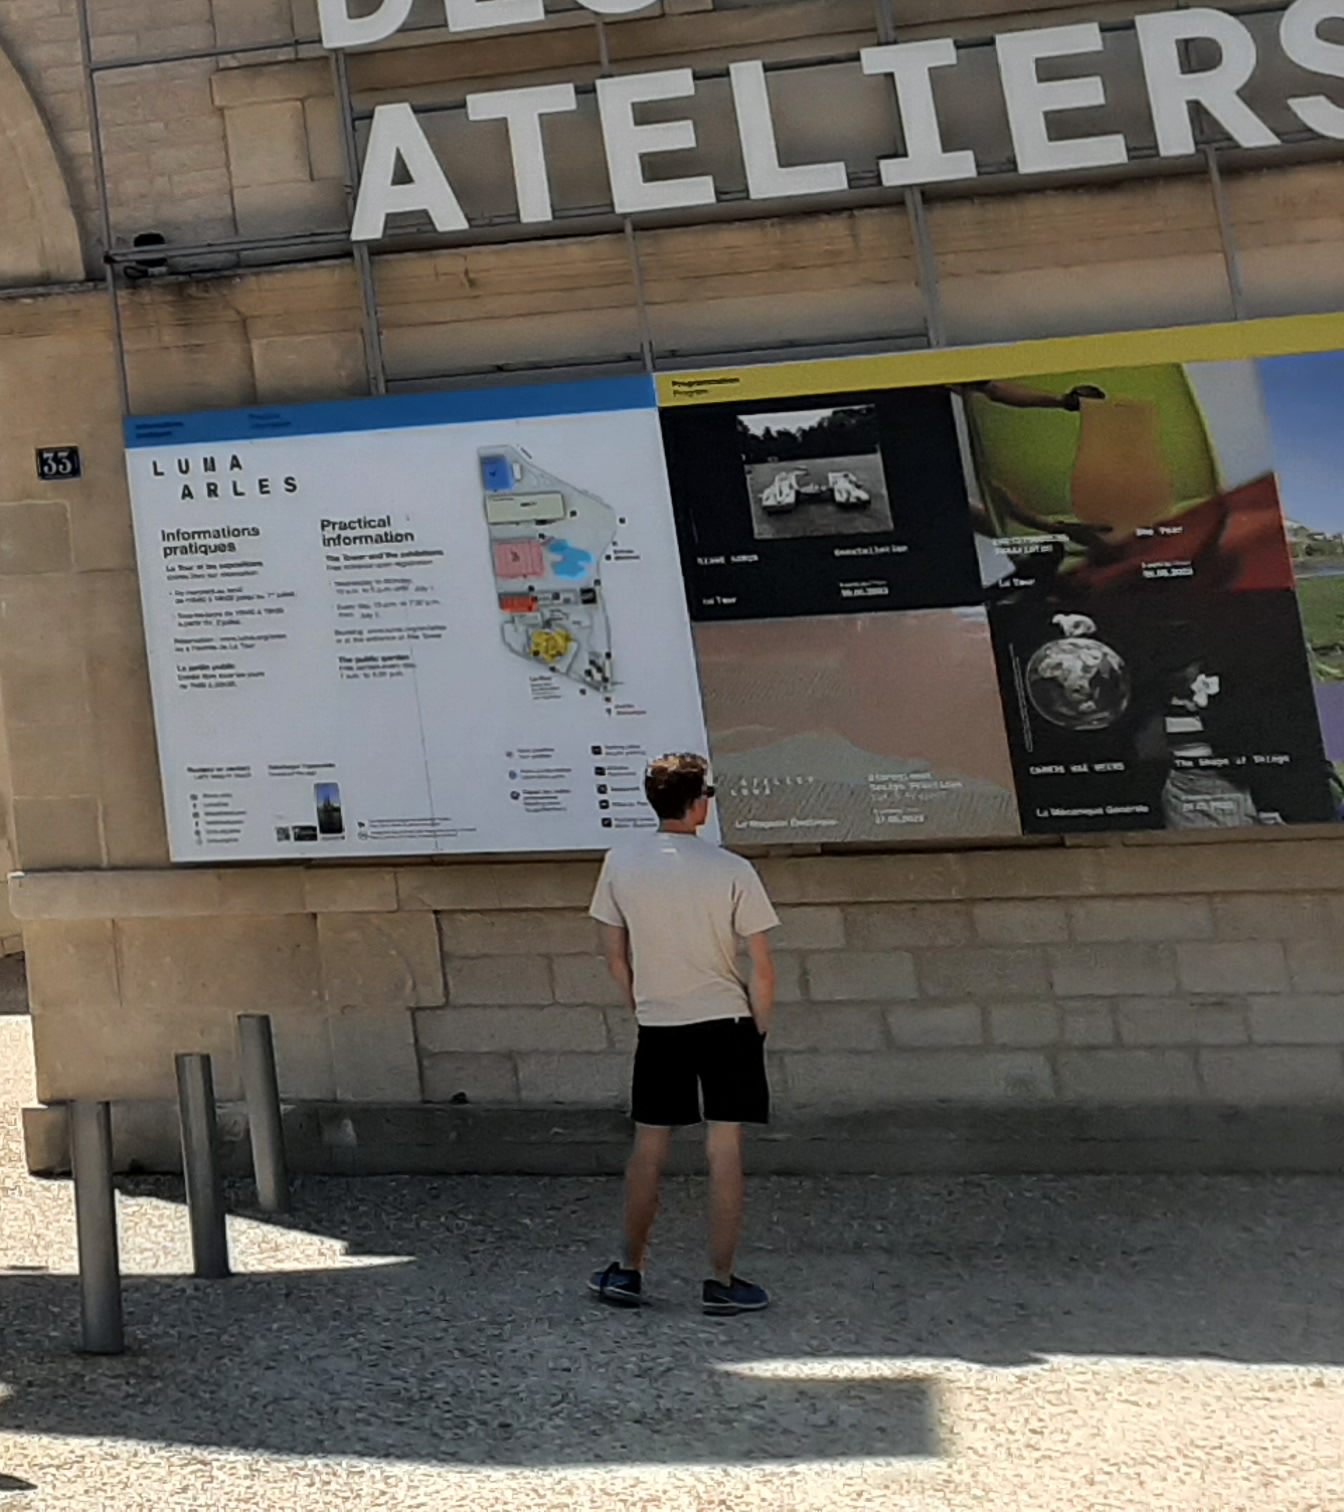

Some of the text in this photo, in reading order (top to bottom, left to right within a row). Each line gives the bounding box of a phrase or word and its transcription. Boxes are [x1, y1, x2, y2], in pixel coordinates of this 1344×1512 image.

[152, 454, 243, 477] LUMA
[181, 476, 298, 500] ARLES
[320, 515, 392, 531] Practical
[161, 525, 261, 542] Informations
[322, 530, 415, 547] information
[163, 542, 237, 559] pratiques
